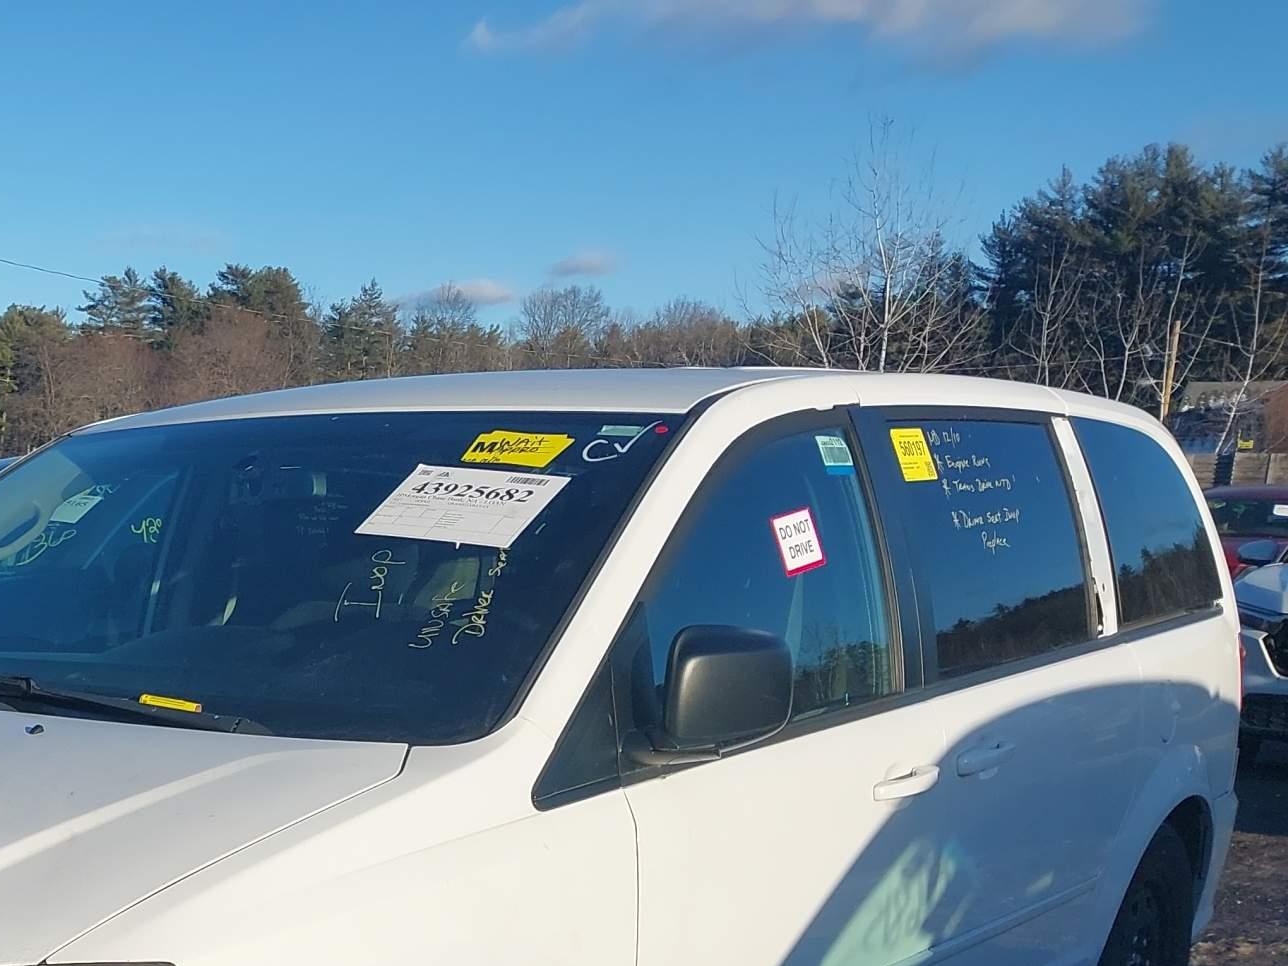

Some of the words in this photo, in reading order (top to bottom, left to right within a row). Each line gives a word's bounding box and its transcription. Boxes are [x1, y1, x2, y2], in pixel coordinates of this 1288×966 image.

[898, 440, 926, 457] 560197
[410, 479, 535, 505] 43925682
[778, 525, 793, 540] DO
[793, 519, 811, 537] NOT
[788, 540, 815, 560] DRIVE
